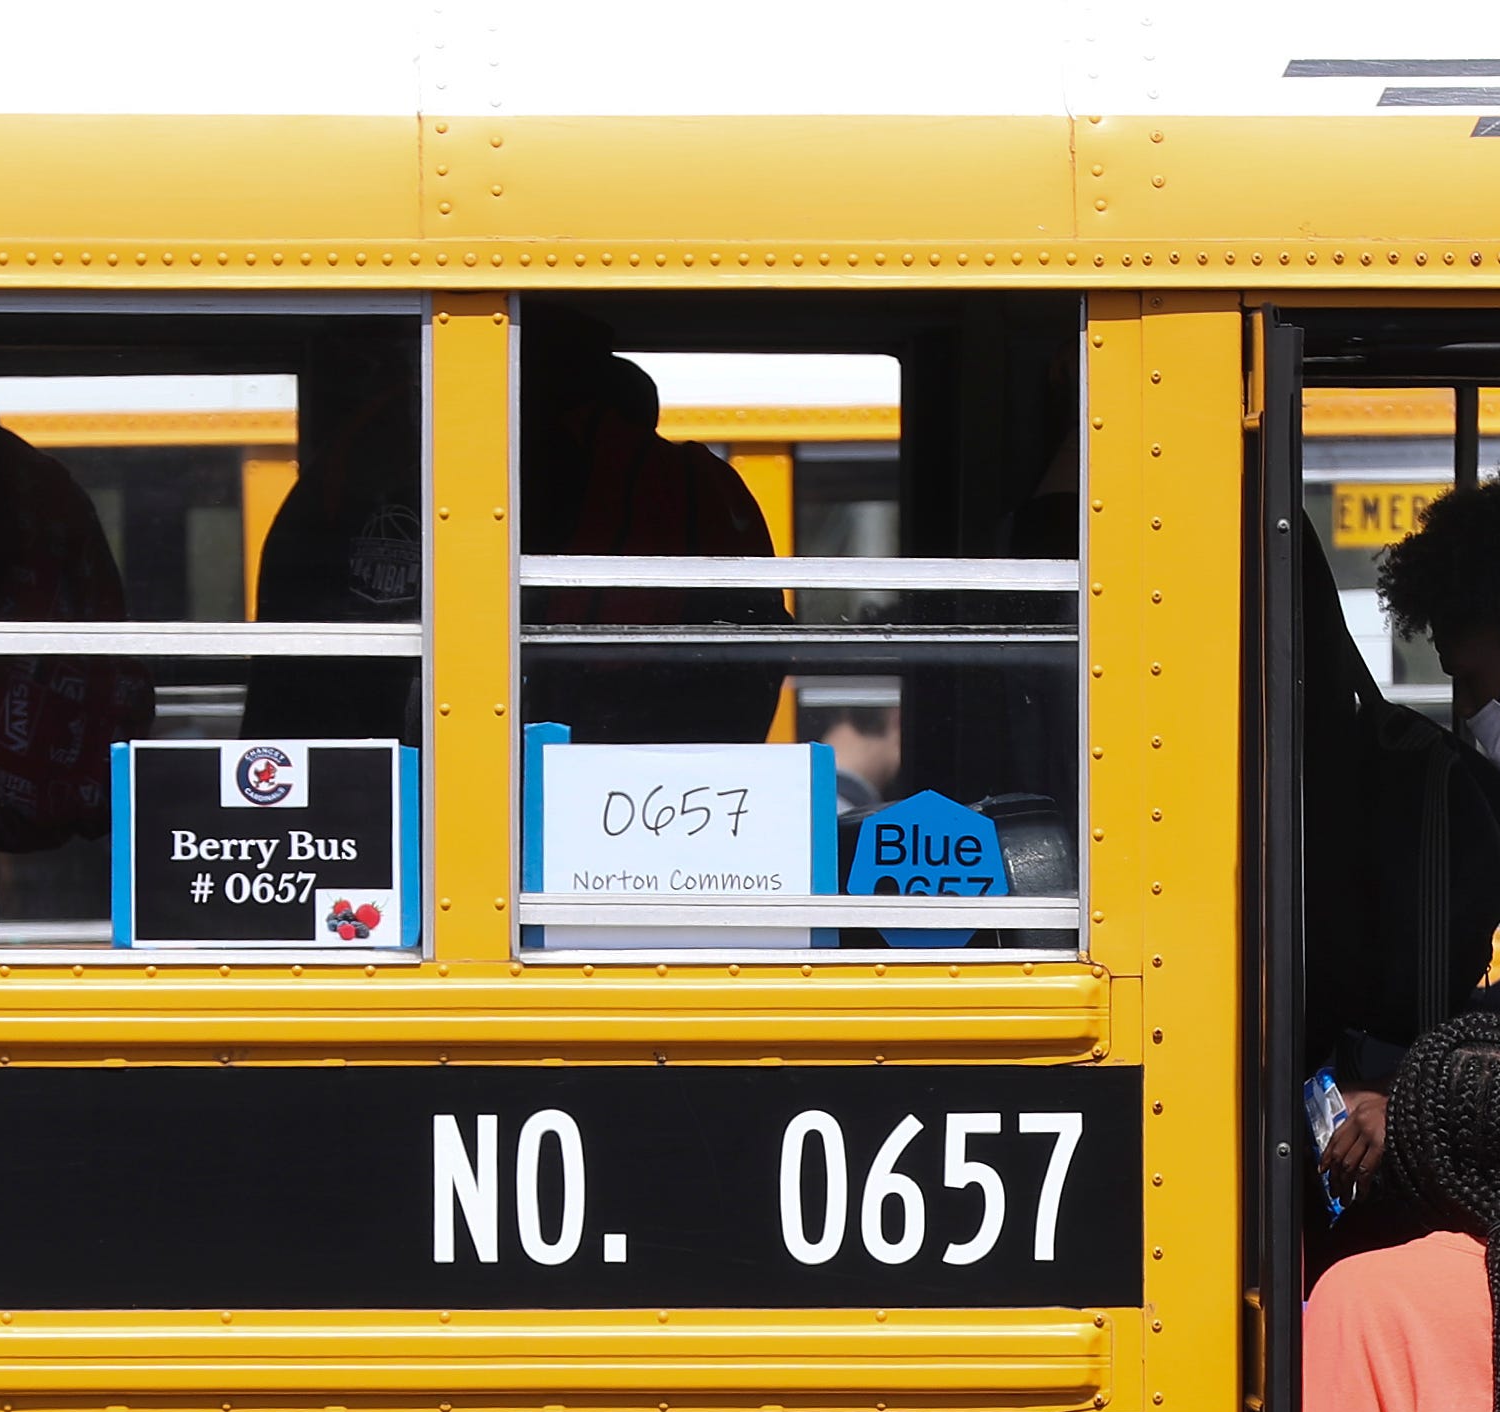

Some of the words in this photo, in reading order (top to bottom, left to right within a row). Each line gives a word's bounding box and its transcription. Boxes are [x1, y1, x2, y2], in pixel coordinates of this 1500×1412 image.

[4, 683, 31, 753] VANS
[602, 785, 750, 837] 0657
[170, 830, 281, 869] Berry
[287, 830, 358, 861] Bus
[874, 823, 983, 867] Blue
[190, 872, 215, 903] #
[224, 872, 317, 904] 0657
[573, 869, 660, 891] Norton
[669, 868, 783, 892] Commons
[432, 1108, 627, 1265] NO.
[779, 1108, 1084, 1265] 0657
